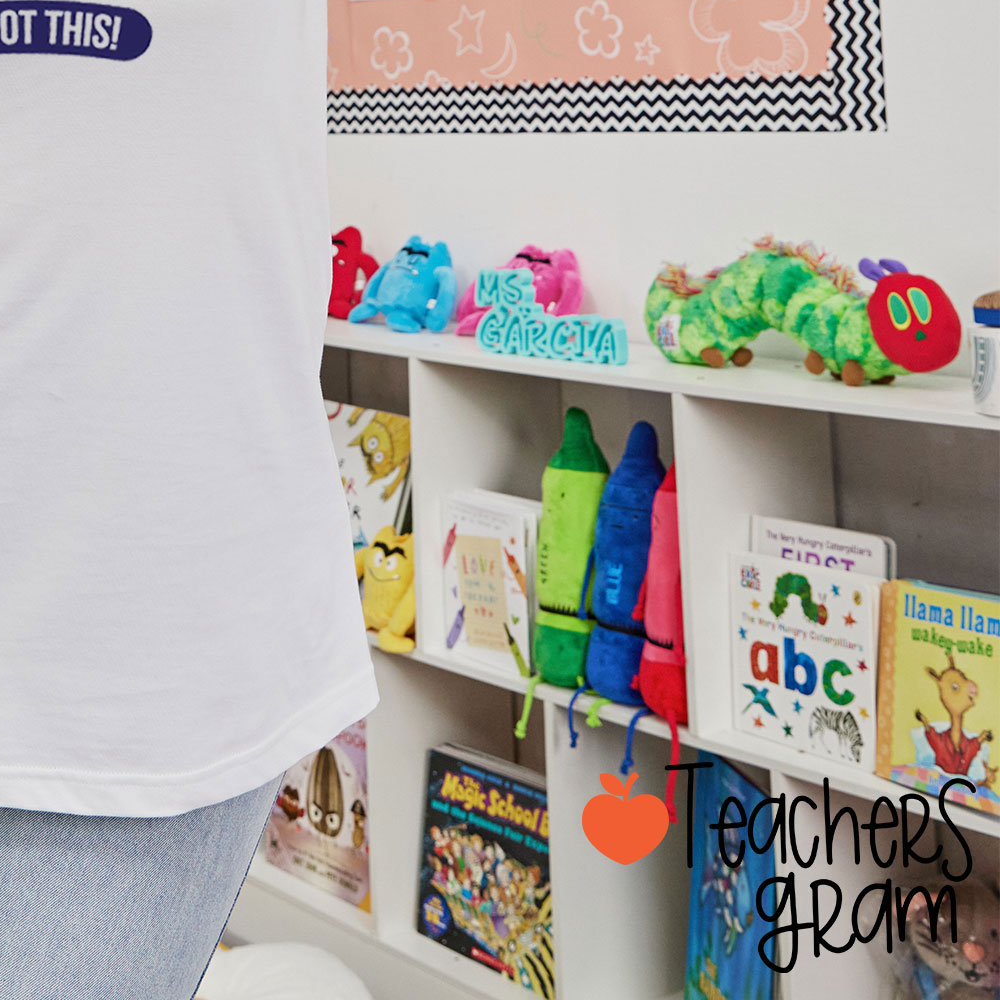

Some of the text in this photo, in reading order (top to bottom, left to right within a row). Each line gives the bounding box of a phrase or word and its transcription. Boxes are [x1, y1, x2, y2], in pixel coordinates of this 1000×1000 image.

[43, 9, 123, 51] THIS!
[475, 308, 624, 364] GARCIA
[904, 594, 954, 627] llama
[750, 637, 855, 706] abc
[441, 772, 487, 810] Magic
[487, 788, 540, 832] School
